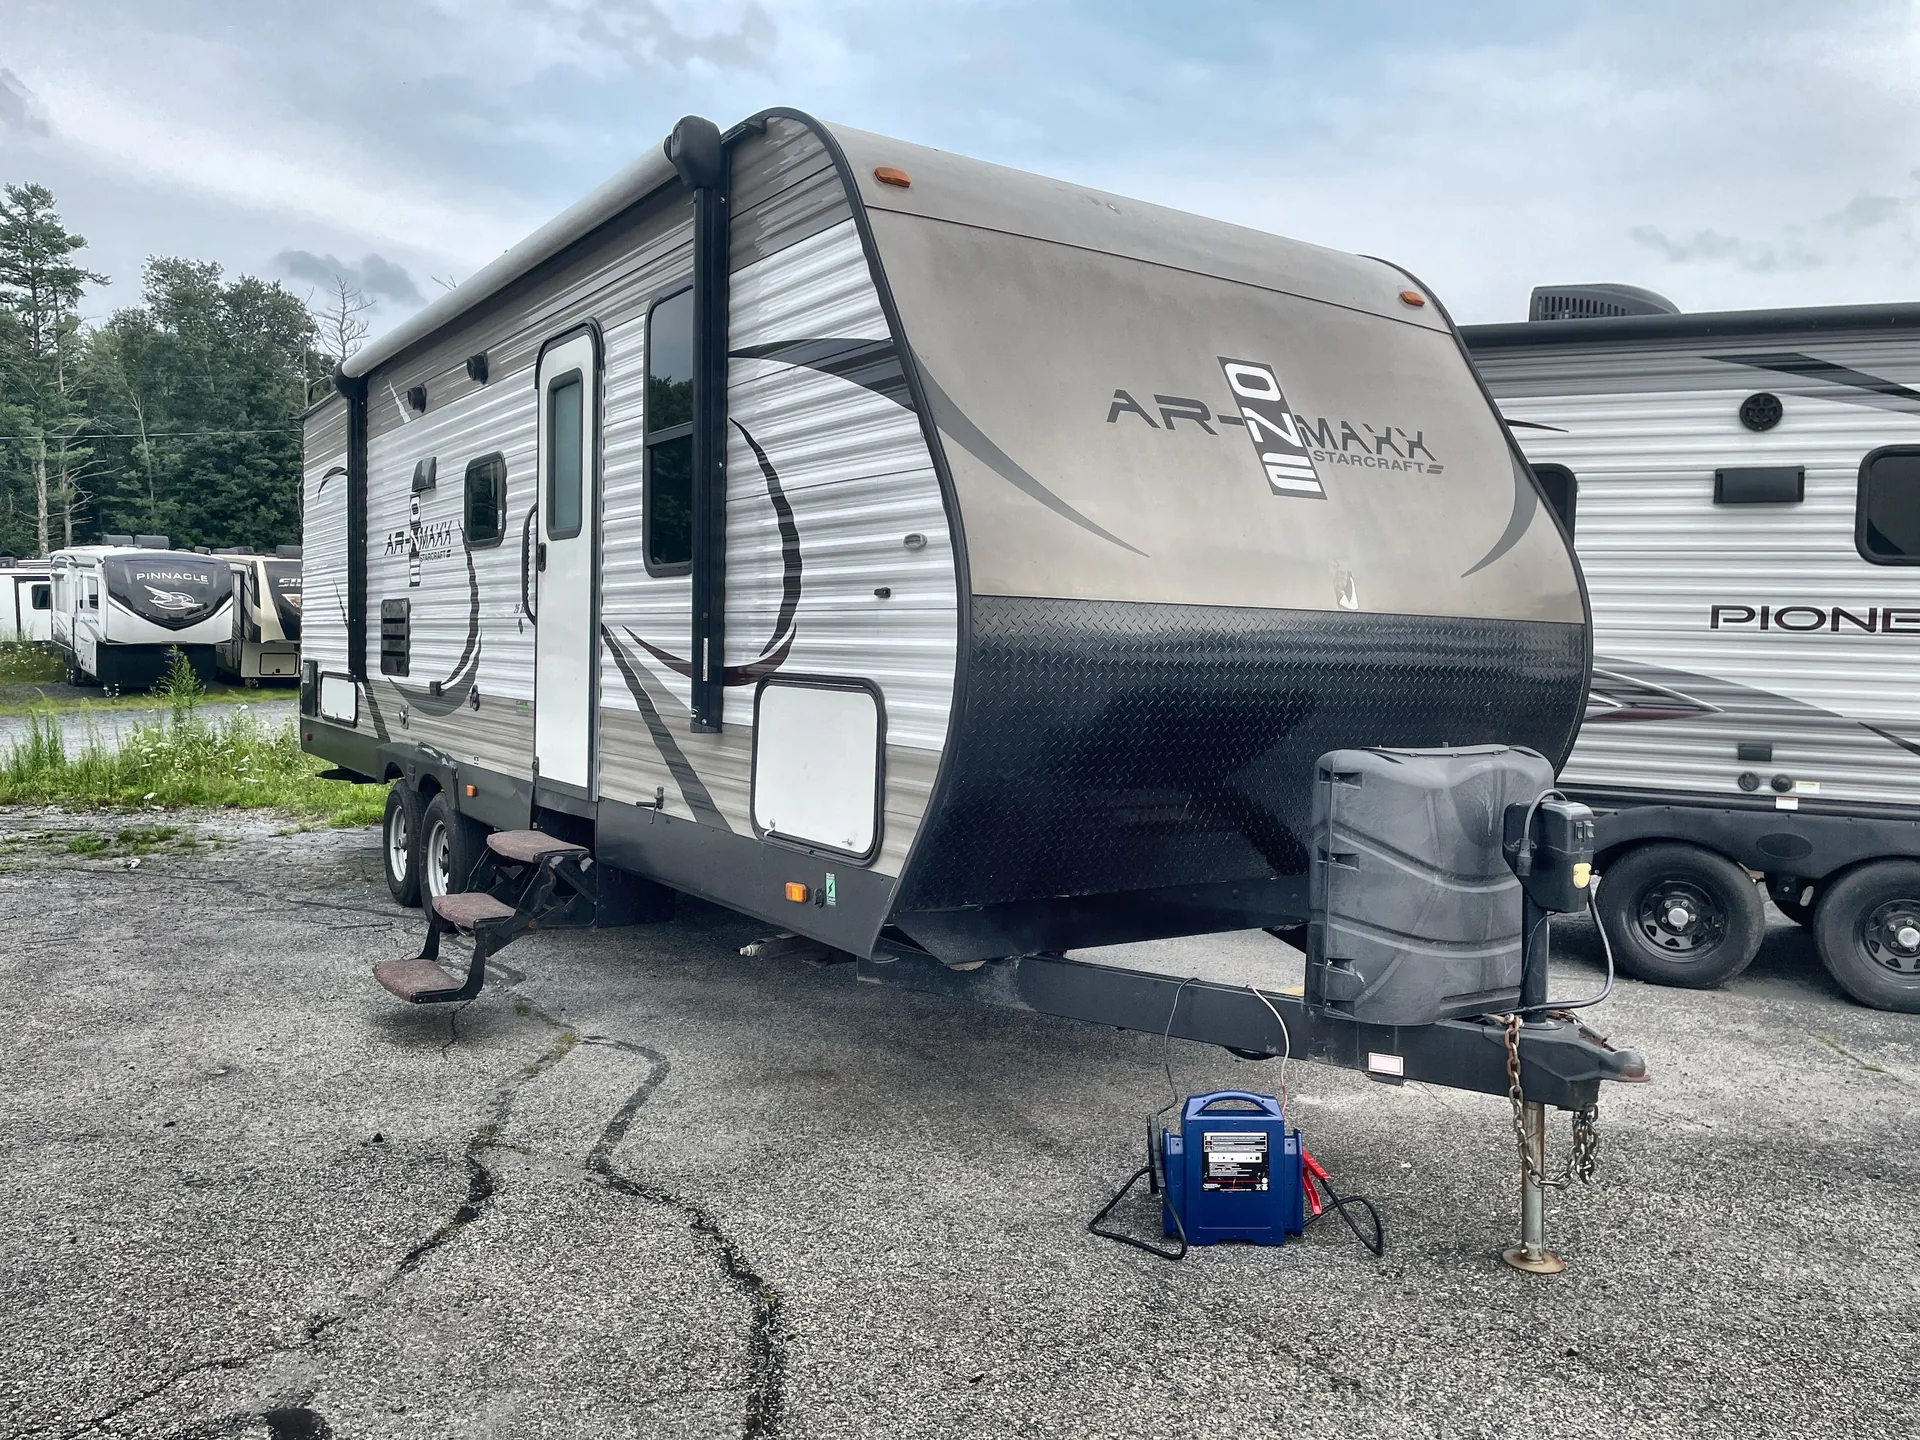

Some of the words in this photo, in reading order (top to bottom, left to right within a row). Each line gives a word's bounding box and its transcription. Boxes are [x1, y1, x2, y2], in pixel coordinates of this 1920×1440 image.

[1225, 361, 1323, 493] ONE
[1294, 414, 1437, 462] MAXX
[1312, 449, 1425, 474] STARCRAFT
[136, 572, 208, 583] PINNACLE
